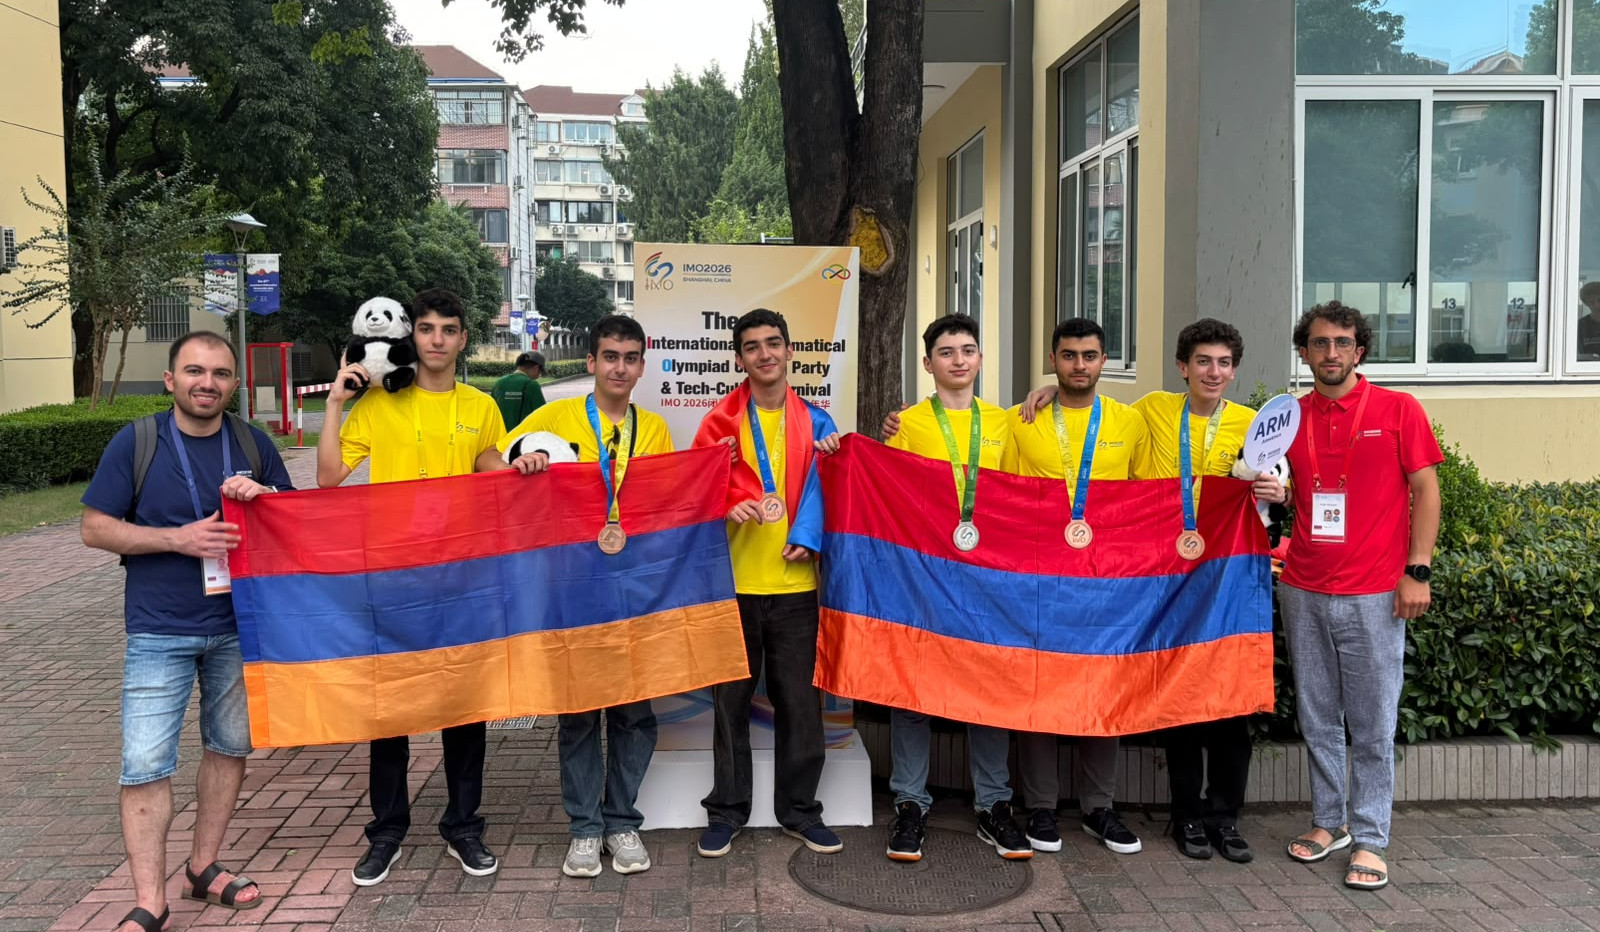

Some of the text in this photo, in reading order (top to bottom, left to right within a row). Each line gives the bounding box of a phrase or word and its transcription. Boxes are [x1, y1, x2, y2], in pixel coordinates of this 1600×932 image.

[683, 263, 732, 273] IMO2026
[1441, 298, 1456, 310] 13
[1510, 298, 1525, 310] 12
[701, 311, 739, 330] The
[647, 336, 846, 352] Internationa matical
[662, 359, 729, 375] Olympiad
[792, 361, 830, 377] Party
[661, 382, 671, 394] &
[661, 399, 680, 407] IMO
[1254, 410, 1291, 441] ARM
